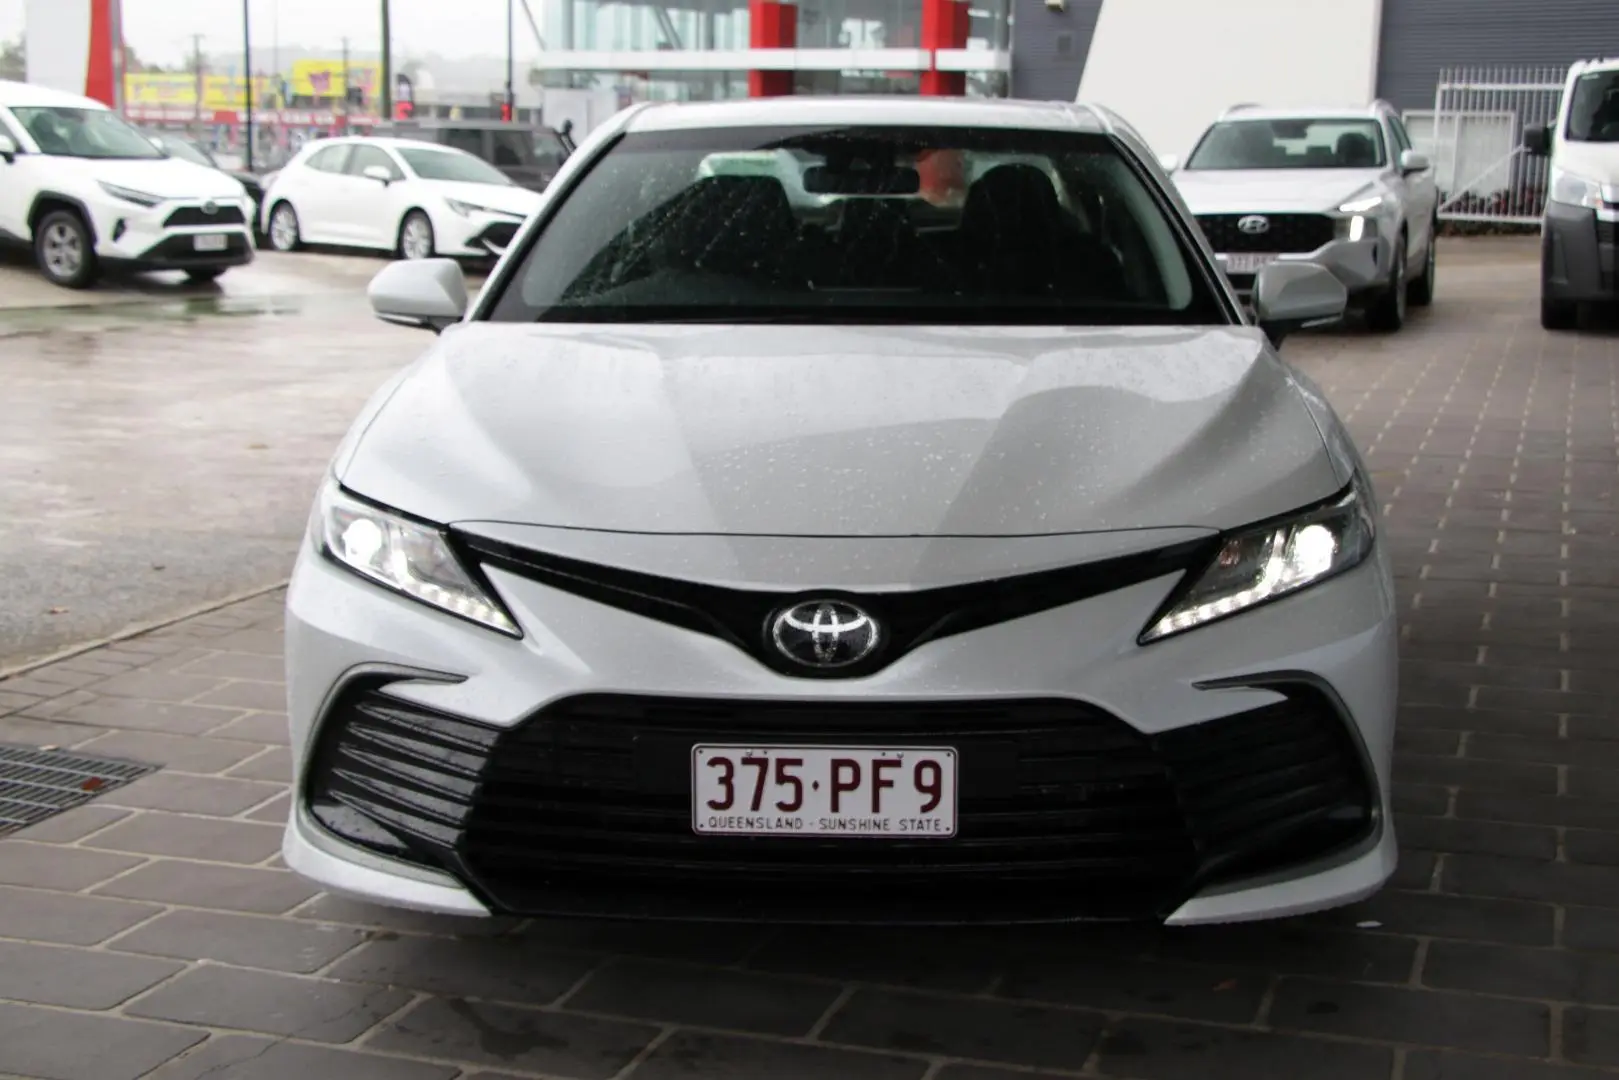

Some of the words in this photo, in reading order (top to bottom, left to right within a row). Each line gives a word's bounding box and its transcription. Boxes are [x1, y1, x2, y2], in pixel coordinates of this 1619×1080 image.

[708, 816, 803, 830] QUEENSLAND
[818, 818, 890, 831] SUNSHINE
[899, 819, 942, 832] STATE
